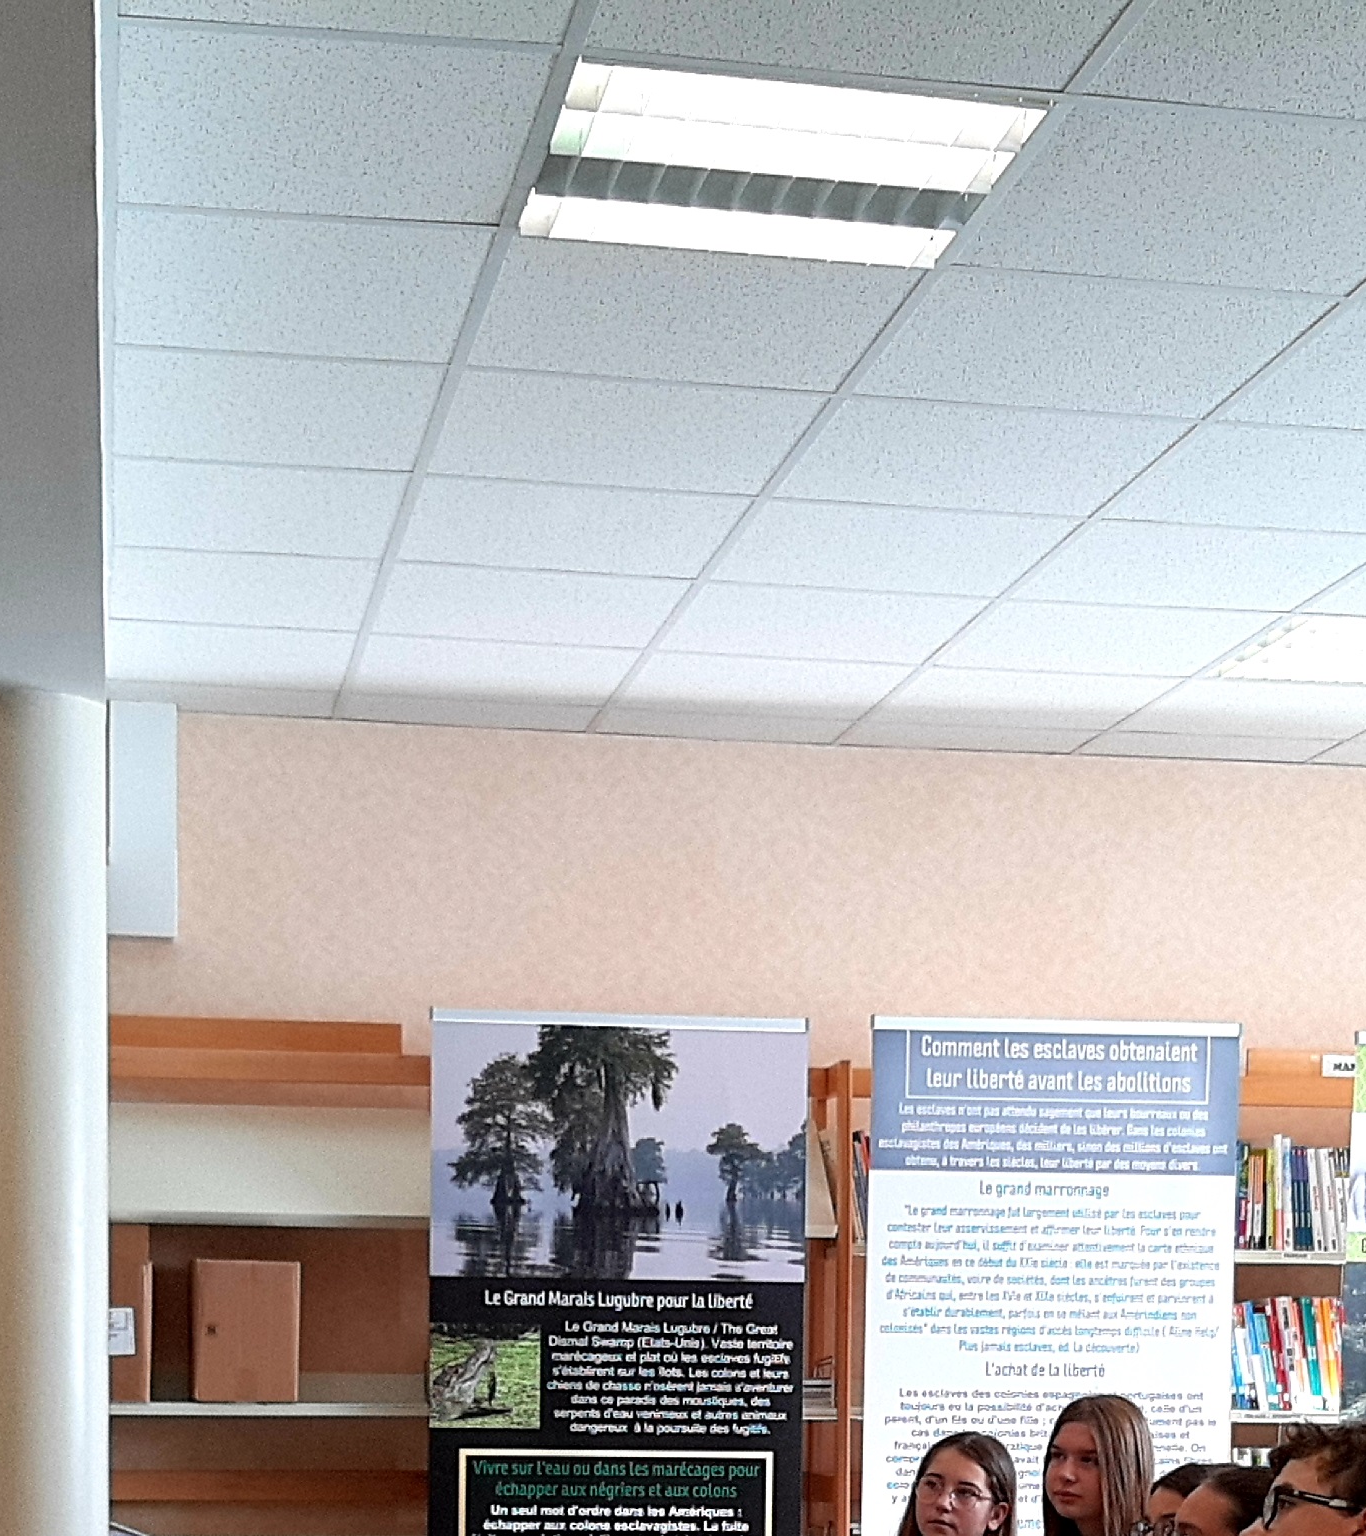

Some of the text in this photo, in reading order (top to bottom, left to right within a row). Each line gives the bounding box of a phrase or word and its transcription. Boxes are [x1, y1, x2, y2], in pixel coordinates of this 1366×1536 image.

[921, 1036, 1198, 1062] Comment les esclaves obtenaient
[926, 1068, 1192, 1093] leur liberté avant les abolitions
[979, 1179, 1109, 1199] Le grand marronnage
[485, 1289, 753, 1311] Le Grand Marais Lugubre pour la liberté
[984, 1362, 1105, 1377] L'achat de la liberté
[471, 1460, 761, 1477] Vivre sur l'eau ou dans les marécages pour
[495, 1481, 737, 1499] échapper aux négriers et aux colons
[489, 1504, 508, 1515] Un
[511, 1504, 537, 1516] seul
[539, 1506, 564, 1516] mot
[567, 1504, 611, 1516] d'ordre
[614, 1506, 644, 1517] dans
[646, 1505, 665, 1517] les
[668, 1506, 734, 1517] Amériques
